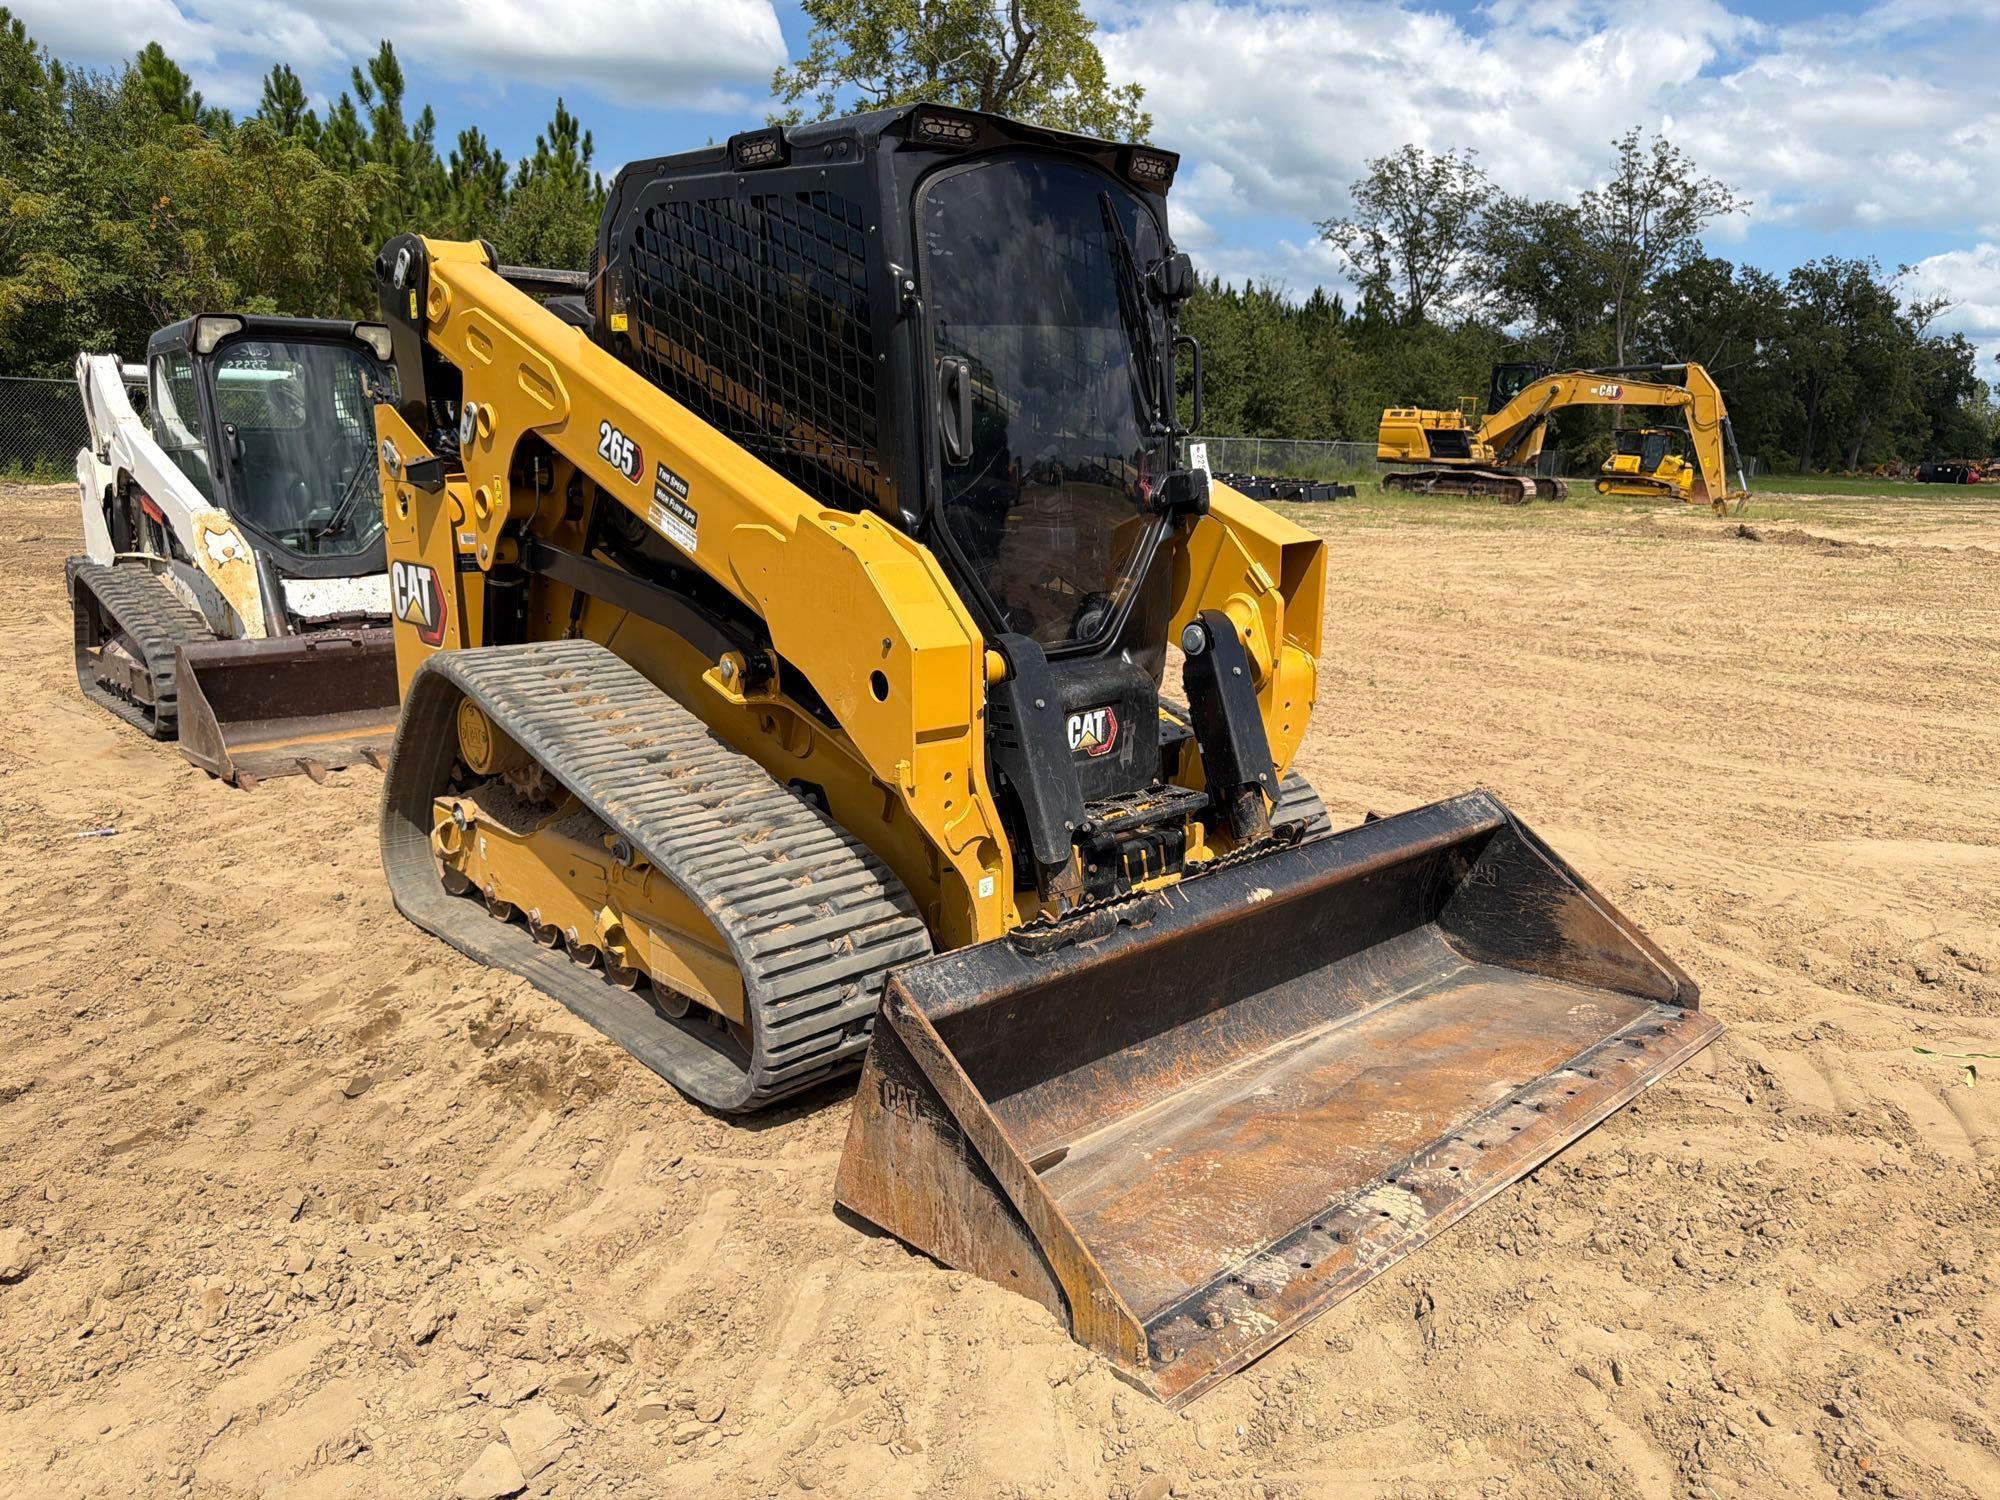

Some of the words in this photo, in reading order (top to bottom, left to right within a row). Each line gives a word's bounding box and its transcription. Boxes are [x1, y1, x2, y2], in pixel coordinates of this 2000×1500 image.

[1599, 384, 1619, 397] CAT
[599, 421, 635, 476] 265
[682, 508, 696, 525] XPS
[392, 560, 433, 627] CAT
[1067, 709, 1106, 750] CAT
[883, 1080, 919, 1122] CAT
